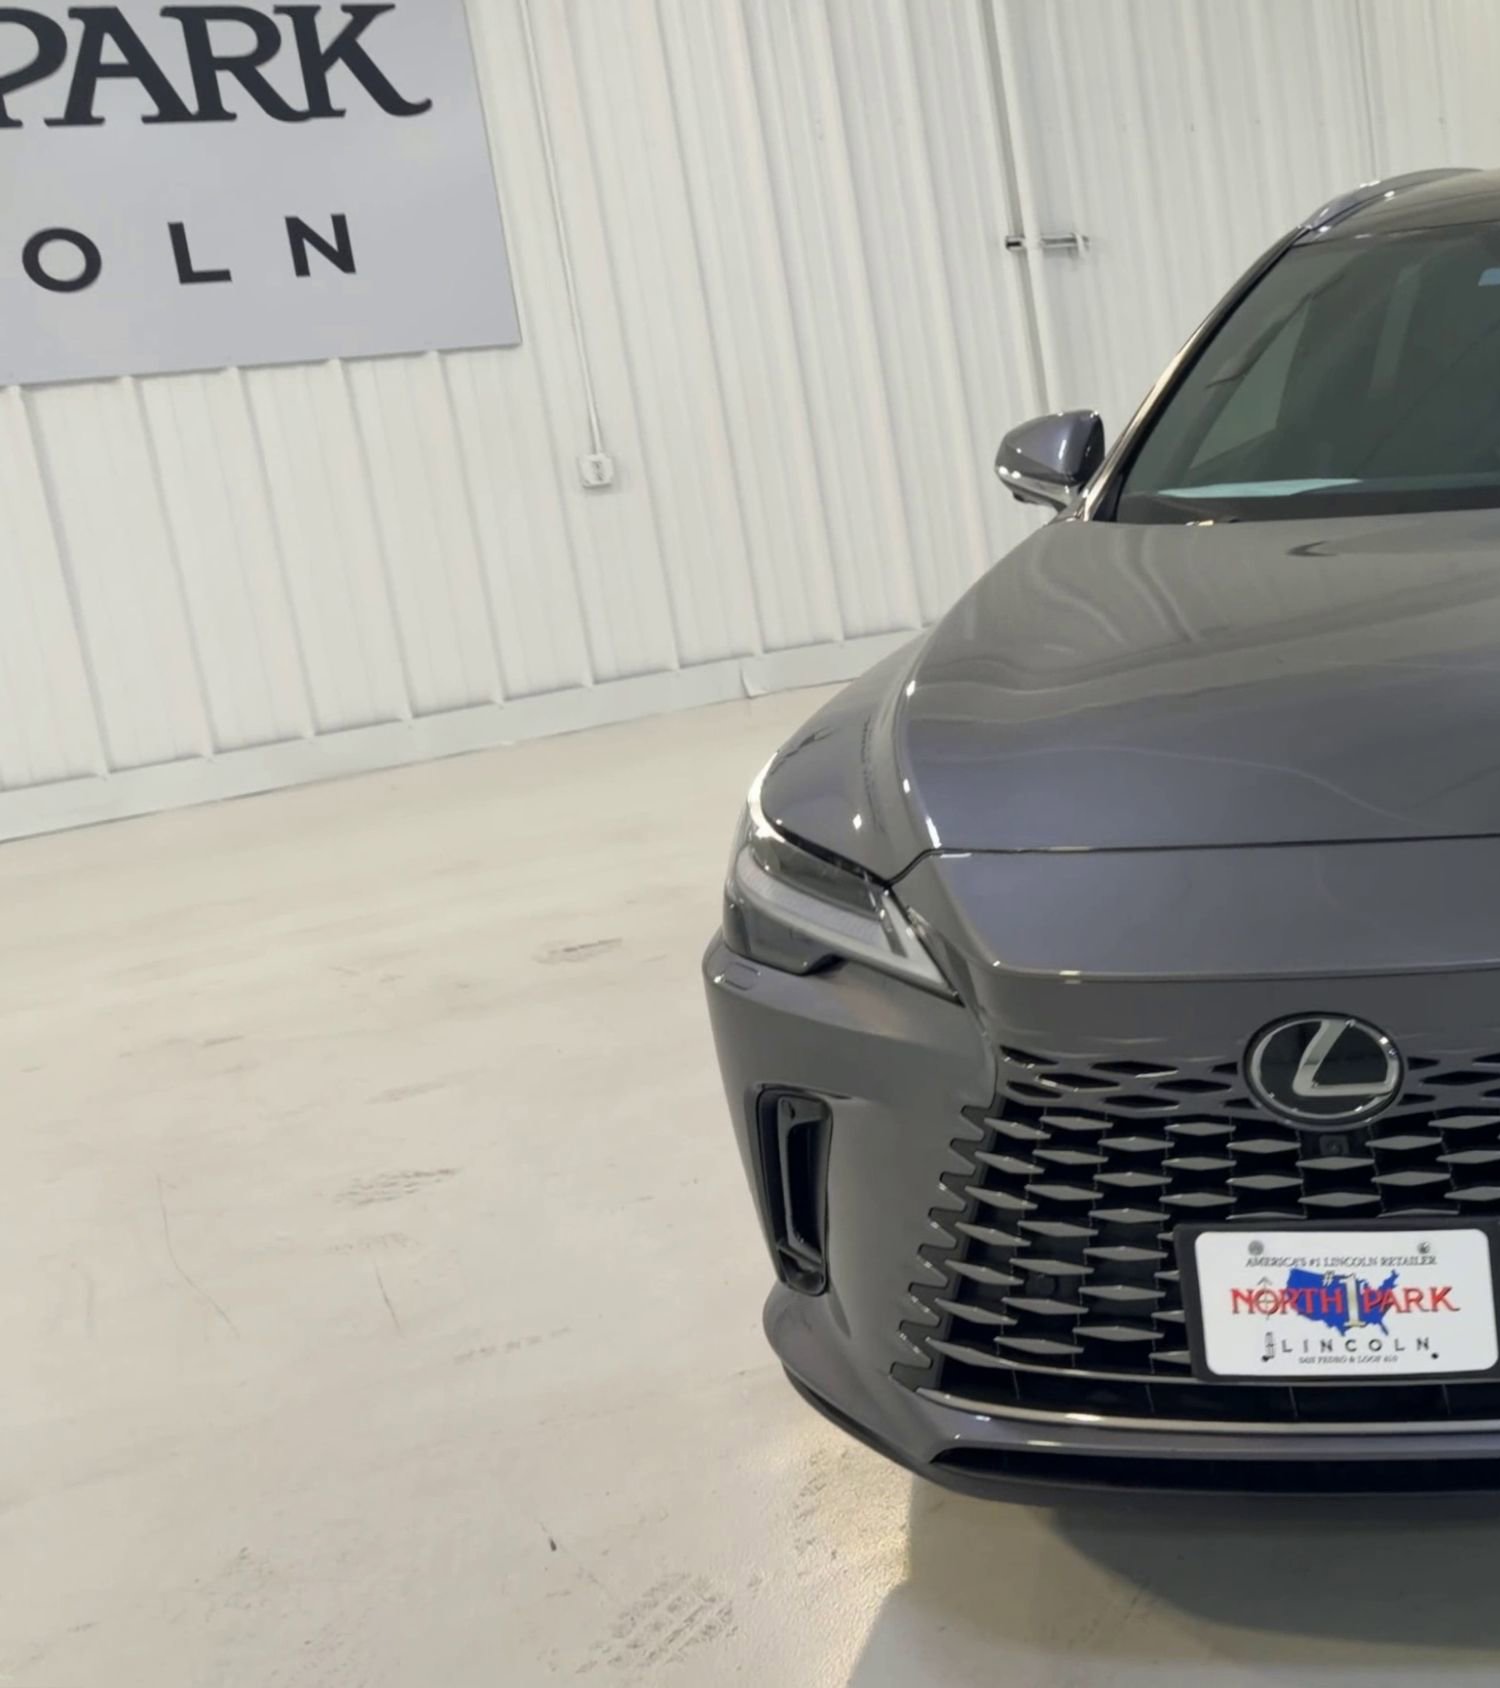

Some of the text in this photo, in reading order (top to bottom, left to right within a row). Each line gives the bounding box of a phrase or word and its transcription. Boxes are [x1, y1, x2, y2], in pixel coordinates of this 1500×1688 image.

[1323, 1255, 1378, 1267] LINCOLN
[1379, 1255, 1437, 1266] RETAILER
[1230, 1286, 1461, 1315] NORTH PARK
[1282, 1337, 1430, 1353] LINCOLN
